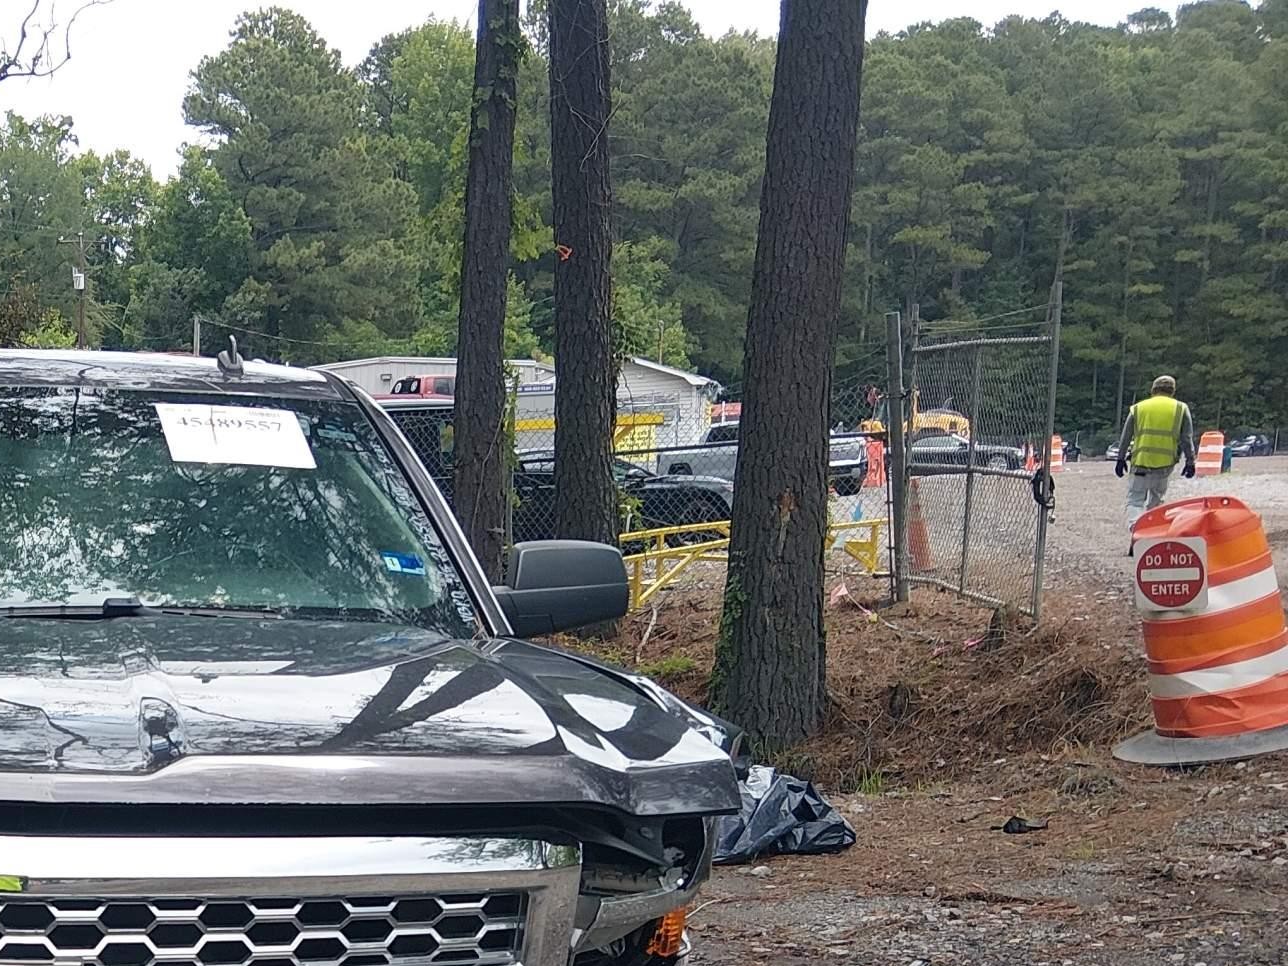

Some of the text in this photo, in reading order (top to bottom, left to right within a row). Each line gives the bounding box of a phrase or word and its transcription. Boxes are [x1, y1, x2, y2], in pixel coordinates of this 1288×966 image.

[176, 416, 281, 432] 45489557
[1145, 553, 1193, 566] DO NOT
[1152, 584, 1189, 595] ENTER
